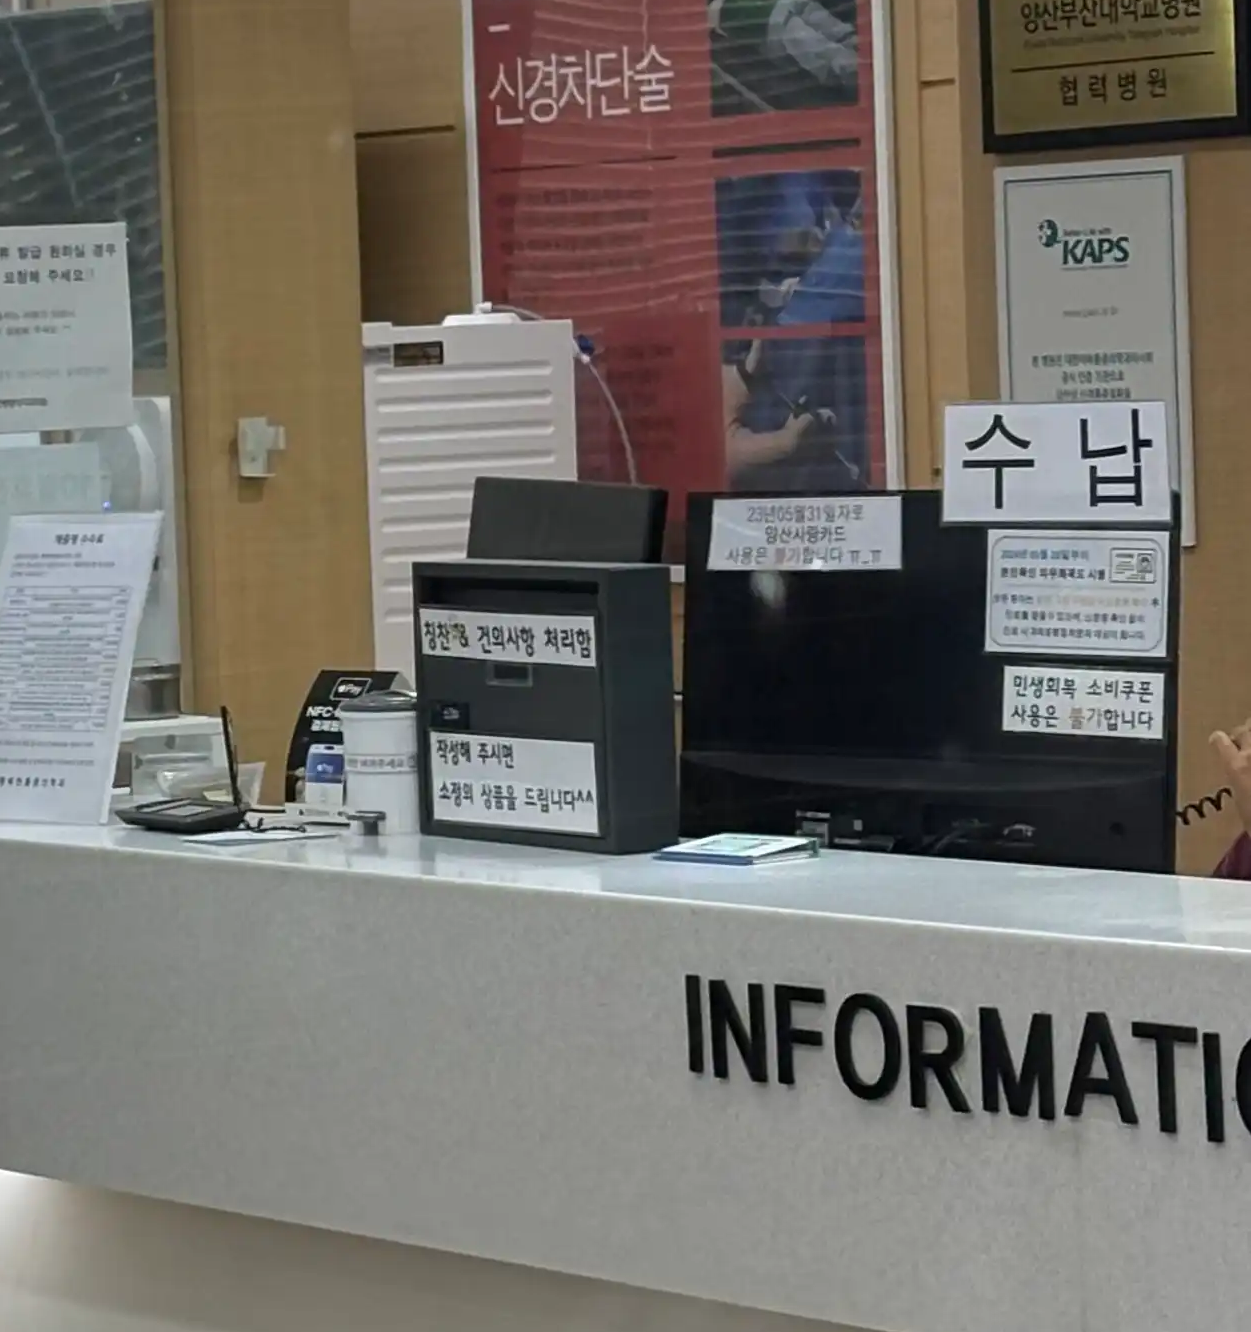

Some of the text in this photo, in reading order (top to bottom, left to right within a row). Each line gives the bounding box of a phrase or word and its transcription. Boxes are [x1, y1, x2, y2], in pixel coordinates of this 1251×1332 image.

[488, 44, 675, 125] 신경차단술
[1062, 236, 1130, 265] KAPS
[746, 504, 864, 523] 23년05월31일자로
[765, 526, 847, 544] 양산사랑카드
[725, 547, 768, 565] 사용은
[774, 546, 843, 565] 불가합니다
[477, 625, 535, 657] 건의사항
[544, 627, 592, 658] 처리함
[1013, 675, 1153, 703] 민생회복 소비쿠폰
[306, 706, 333, 717] NFC
[1011, 704, 1154, 731] 사용은 불가합니다
[436, 740, 471, 765] 작성해
[477, 743, 514, 769] 주시면
[439, 781, 474, 807] 소정의
[481, 783, 517, 811] 상품을
[685, 974, 1251, 1144] INFORMATI
